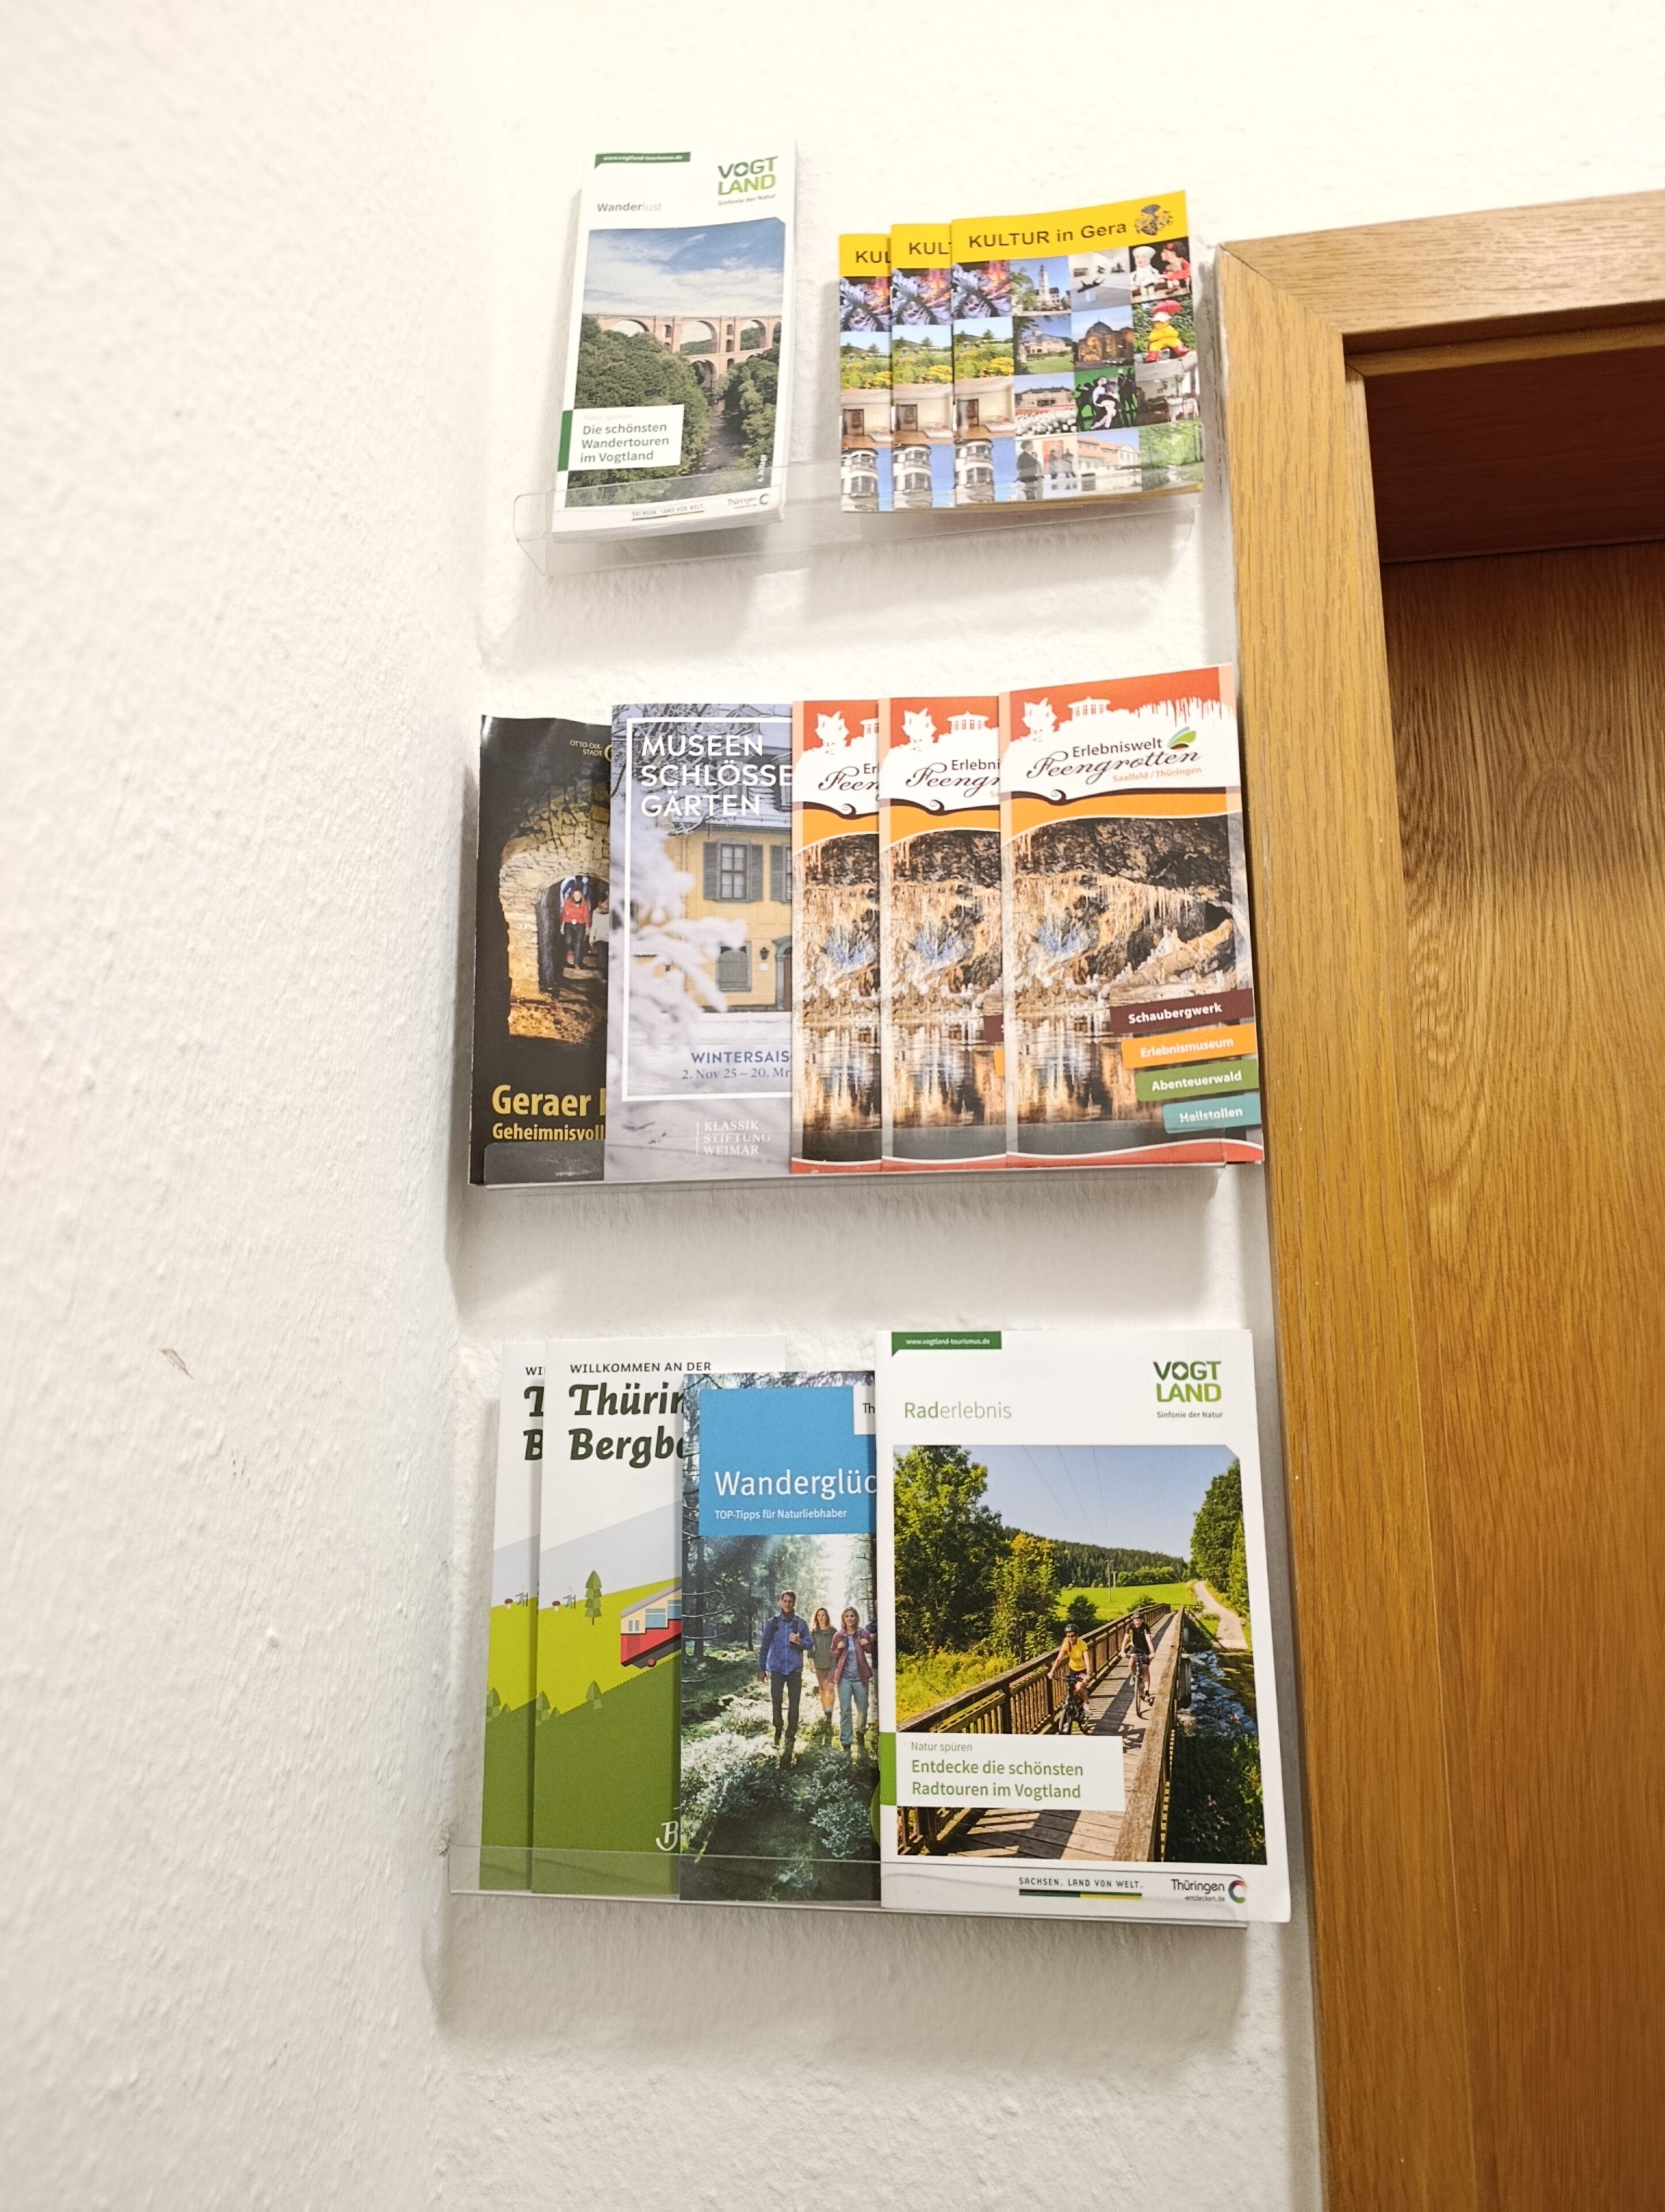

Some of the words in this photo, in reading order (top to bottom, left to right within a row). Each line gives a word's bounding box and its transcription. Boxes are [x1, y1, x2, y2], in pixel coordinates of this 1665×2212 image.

[718, 156, 779, 179] VOGT
[718, 174, 776, 195] LAND
[597, 202, 662, 212] Wanderlust
[969, 230, 1050, 249] KULTUR
[1057, 229, 1074, 243] in
[1081, 222, 1127, 238] Gera
[909, 242, 951, 255] KUL
[583, 425, 602, 435] Die
[605, 423, 667, 434] schönsten
[581, 437, 669, 449] Wandertouren
[581, 453, 596, 463] im
[599, 450, 654, 464] Vogtland
[570, 740, 601, 749] OTTO-DIX
[641, 734, 763, 757] MUSEEN
[1073, 737, 1163, 757] Erlebniswelt
[951, 758, 1000, 770] Erlebni
[1026, 751, 1201, 785] Feengrotten
[640, 760, 792, 787] SCHLÖSSE
[1112, 771, 1148, 782] Saalfeld
[1155, 766, 1203, 779] Thüringen
[640, 790, 760, 817] GÄRTEN
[1128, 1002, 1223, 1024] Schaubergwerk
[1140, 1038, 1234, 1058] Erlebnismuseum
[691, 1050, 792, 1064] WINTERSAIS
[681, 1069, 693, 1080] 2.
[696, 1069, 719, 1079] Nov
[723, 1069, 737, 1078] 25
[750, 1067, 769, 1078] 20.
[1152, 1070, 1242, 1092] Abenteuerwald
[492, 1084, 592, 1116] Geraer
[1179, 1107, 1243, 1123] Heilstollen
[492, 1122, 605, 1141] Geheimnisvoll
[704, 1120, 759, 1131] KLASSIK
[703, 1133, 771, 1144] STIFTUNG
[703, 1145, 759, 1156] WEIMAR
[906, 1338, 991, 1346] www.vogtland-tourismus.de
[525, 1366, 546, 1376] WI
[570, 1362, 660, 1373] WILLKOMMEN
[664, 1362, 682, 1372] AN
[687, 1362, 711, 1372] DER
[1153, 1361, 1222, 1381] VOGT
[1156, 1383, 1222, 1402] LAND
[862, 1403, 875, 1414] Th
[904, 1401, 1012, 1419] Raderlebnis
[714, 1468, 877, 1501] Wanderglüc
[714, 1510, 760, 1521] TOP-Tipps
[762, 1509, 776, 1519] für
[777, 1508, 847, 1518] Naturliebhaber
[911, 1741, 938, 1752] Natur
[939, 1742, 973, 1753] spüren
[912, 1759, 979, 1774] Entdecke
[983, 1760, 1004, 1774] die
[1008, 1761, 1084, 1776] schönsten
[912, 1781, 988, 1796] Radtouren
[993, 1782, 1011, 1797] im
[1014, 1783, 1081, 1801] Vogtland
[1068, 1878, 1091, 1887] LAND
[1094, 1880, 1112, 1888] VON
[1171, 1879, 1226, 1895] Thüringen
